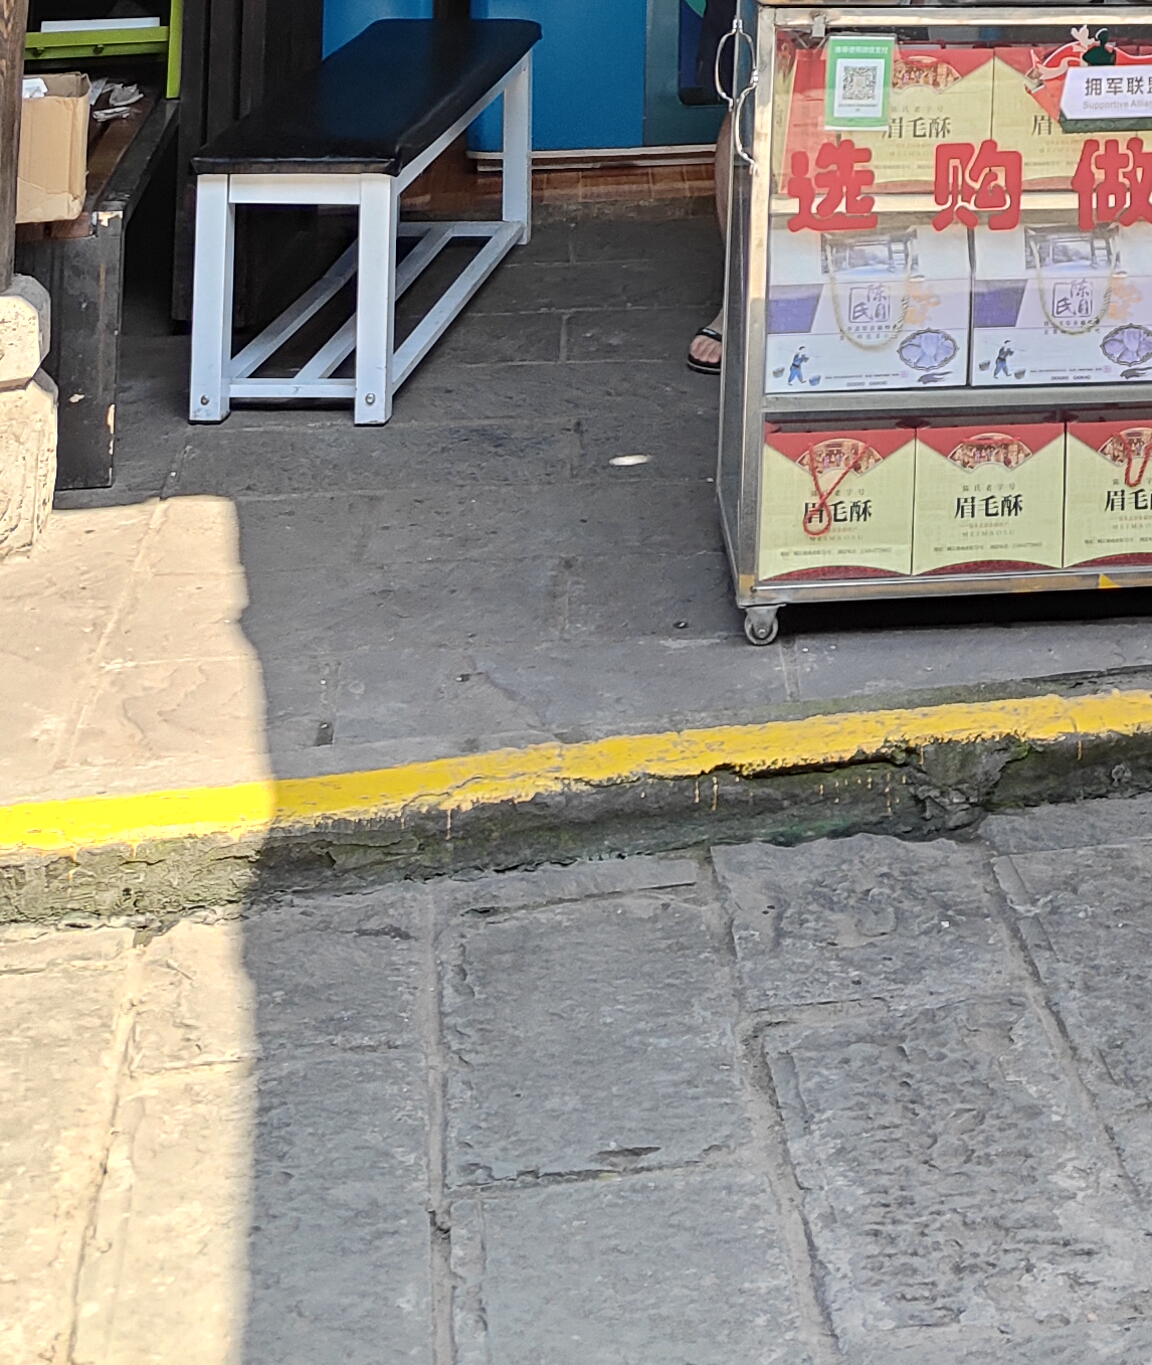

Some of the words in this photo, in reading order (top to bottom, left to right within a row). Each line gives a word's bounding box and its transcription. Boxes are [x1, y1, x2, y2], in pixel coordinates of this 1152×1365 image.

[1083, 100, 1129, 111] Supportive
[954, 493, 1024, 519] 眉毛酥
